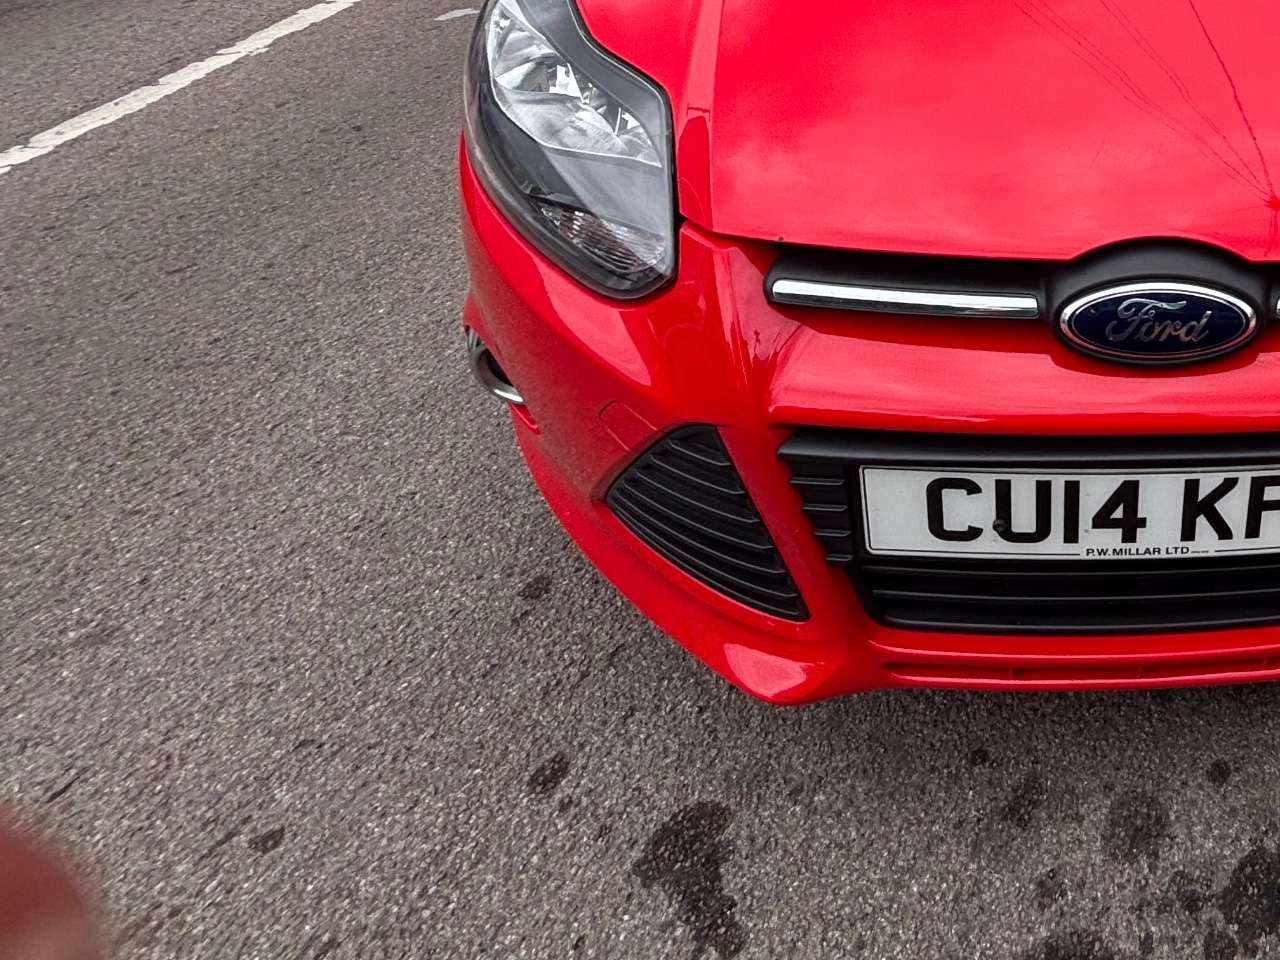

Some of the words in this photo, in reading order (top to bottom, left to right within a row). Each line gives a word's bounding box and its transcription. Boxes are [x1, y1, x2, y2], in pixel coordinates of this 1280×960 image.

[1105, 297, 1213, 342] Ford
[926, 477, 1148, 544] CU14
[1165, 546, 1190, 555] LTD
